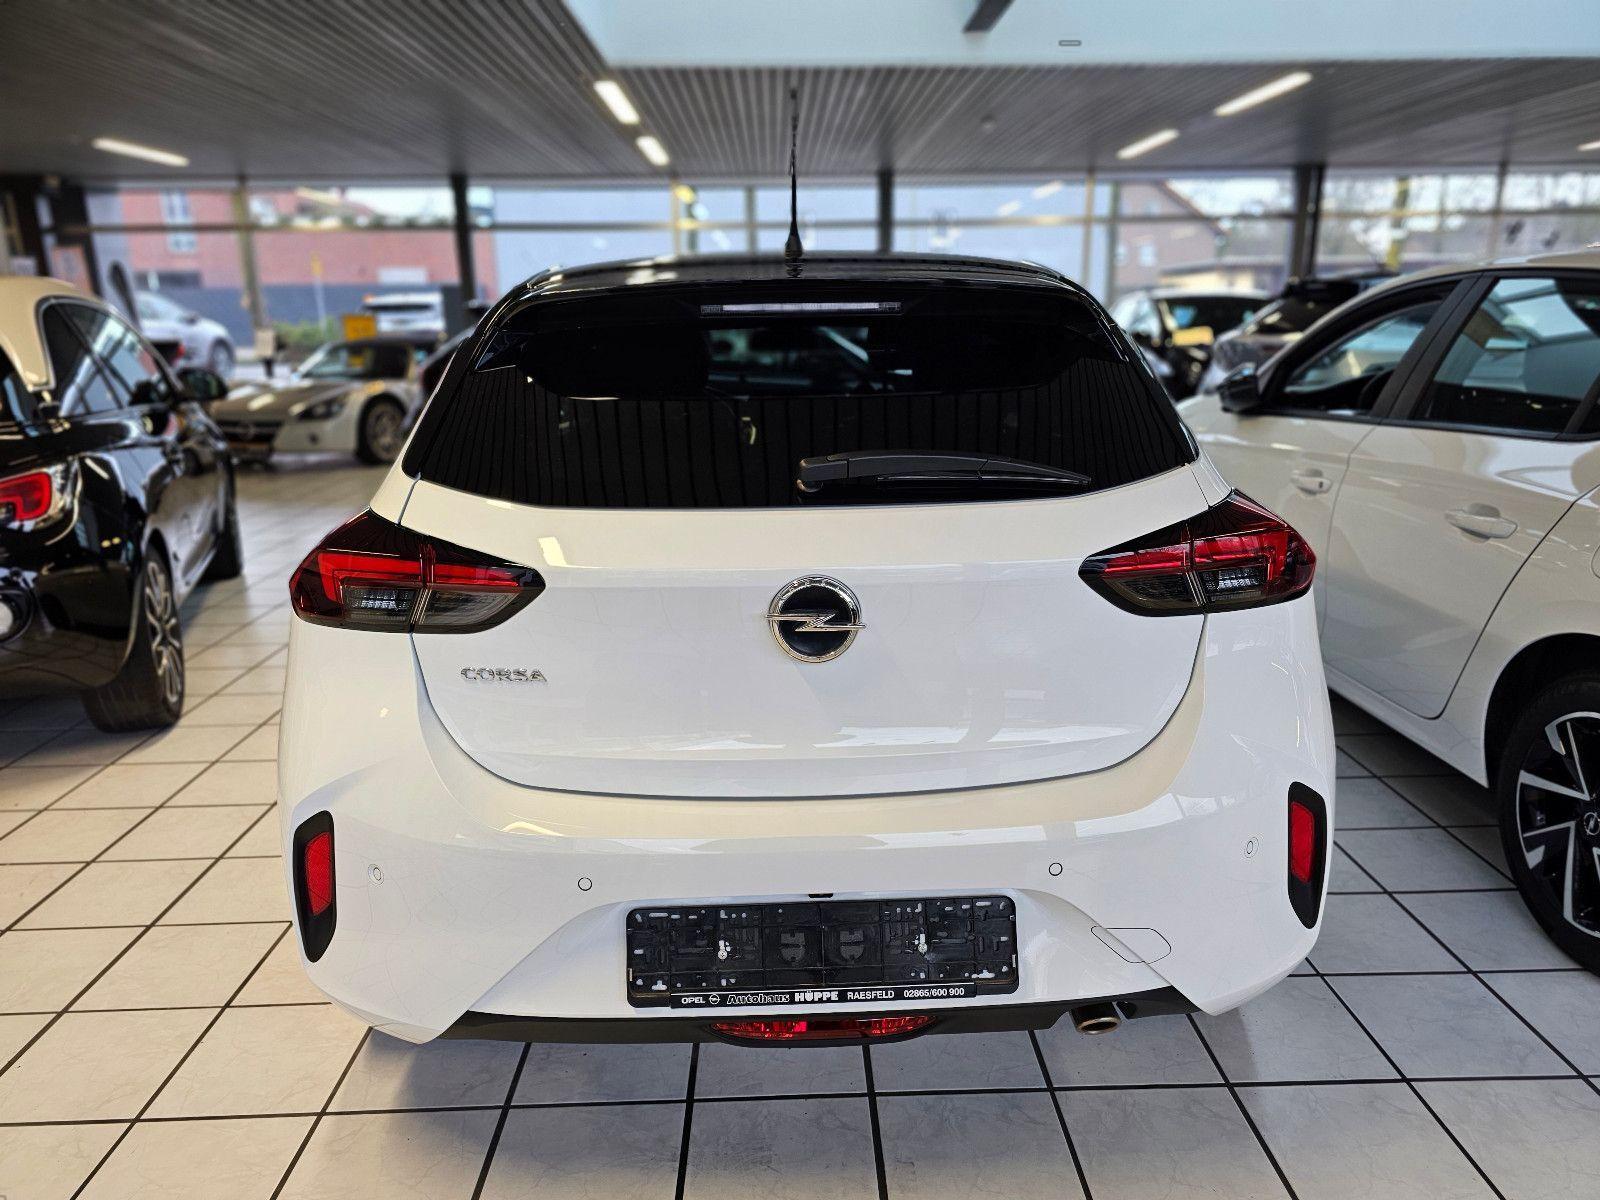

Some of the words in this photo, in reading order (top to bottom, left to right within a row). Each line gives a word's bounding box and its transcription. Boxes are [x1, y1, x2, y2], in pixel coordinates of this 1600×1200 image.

[460, 667, 547, 682] CORSA
[681, 996, 706, 1005] OPEL
[726, 993, 790, 1005] Autohaus
[794, 990, 839, 1002] HÜPPE
[847, 990, 895, 1000] RAESFELD
[903, 988, 948, 998] 02865/600
[949, 987, 965, 996] 900
